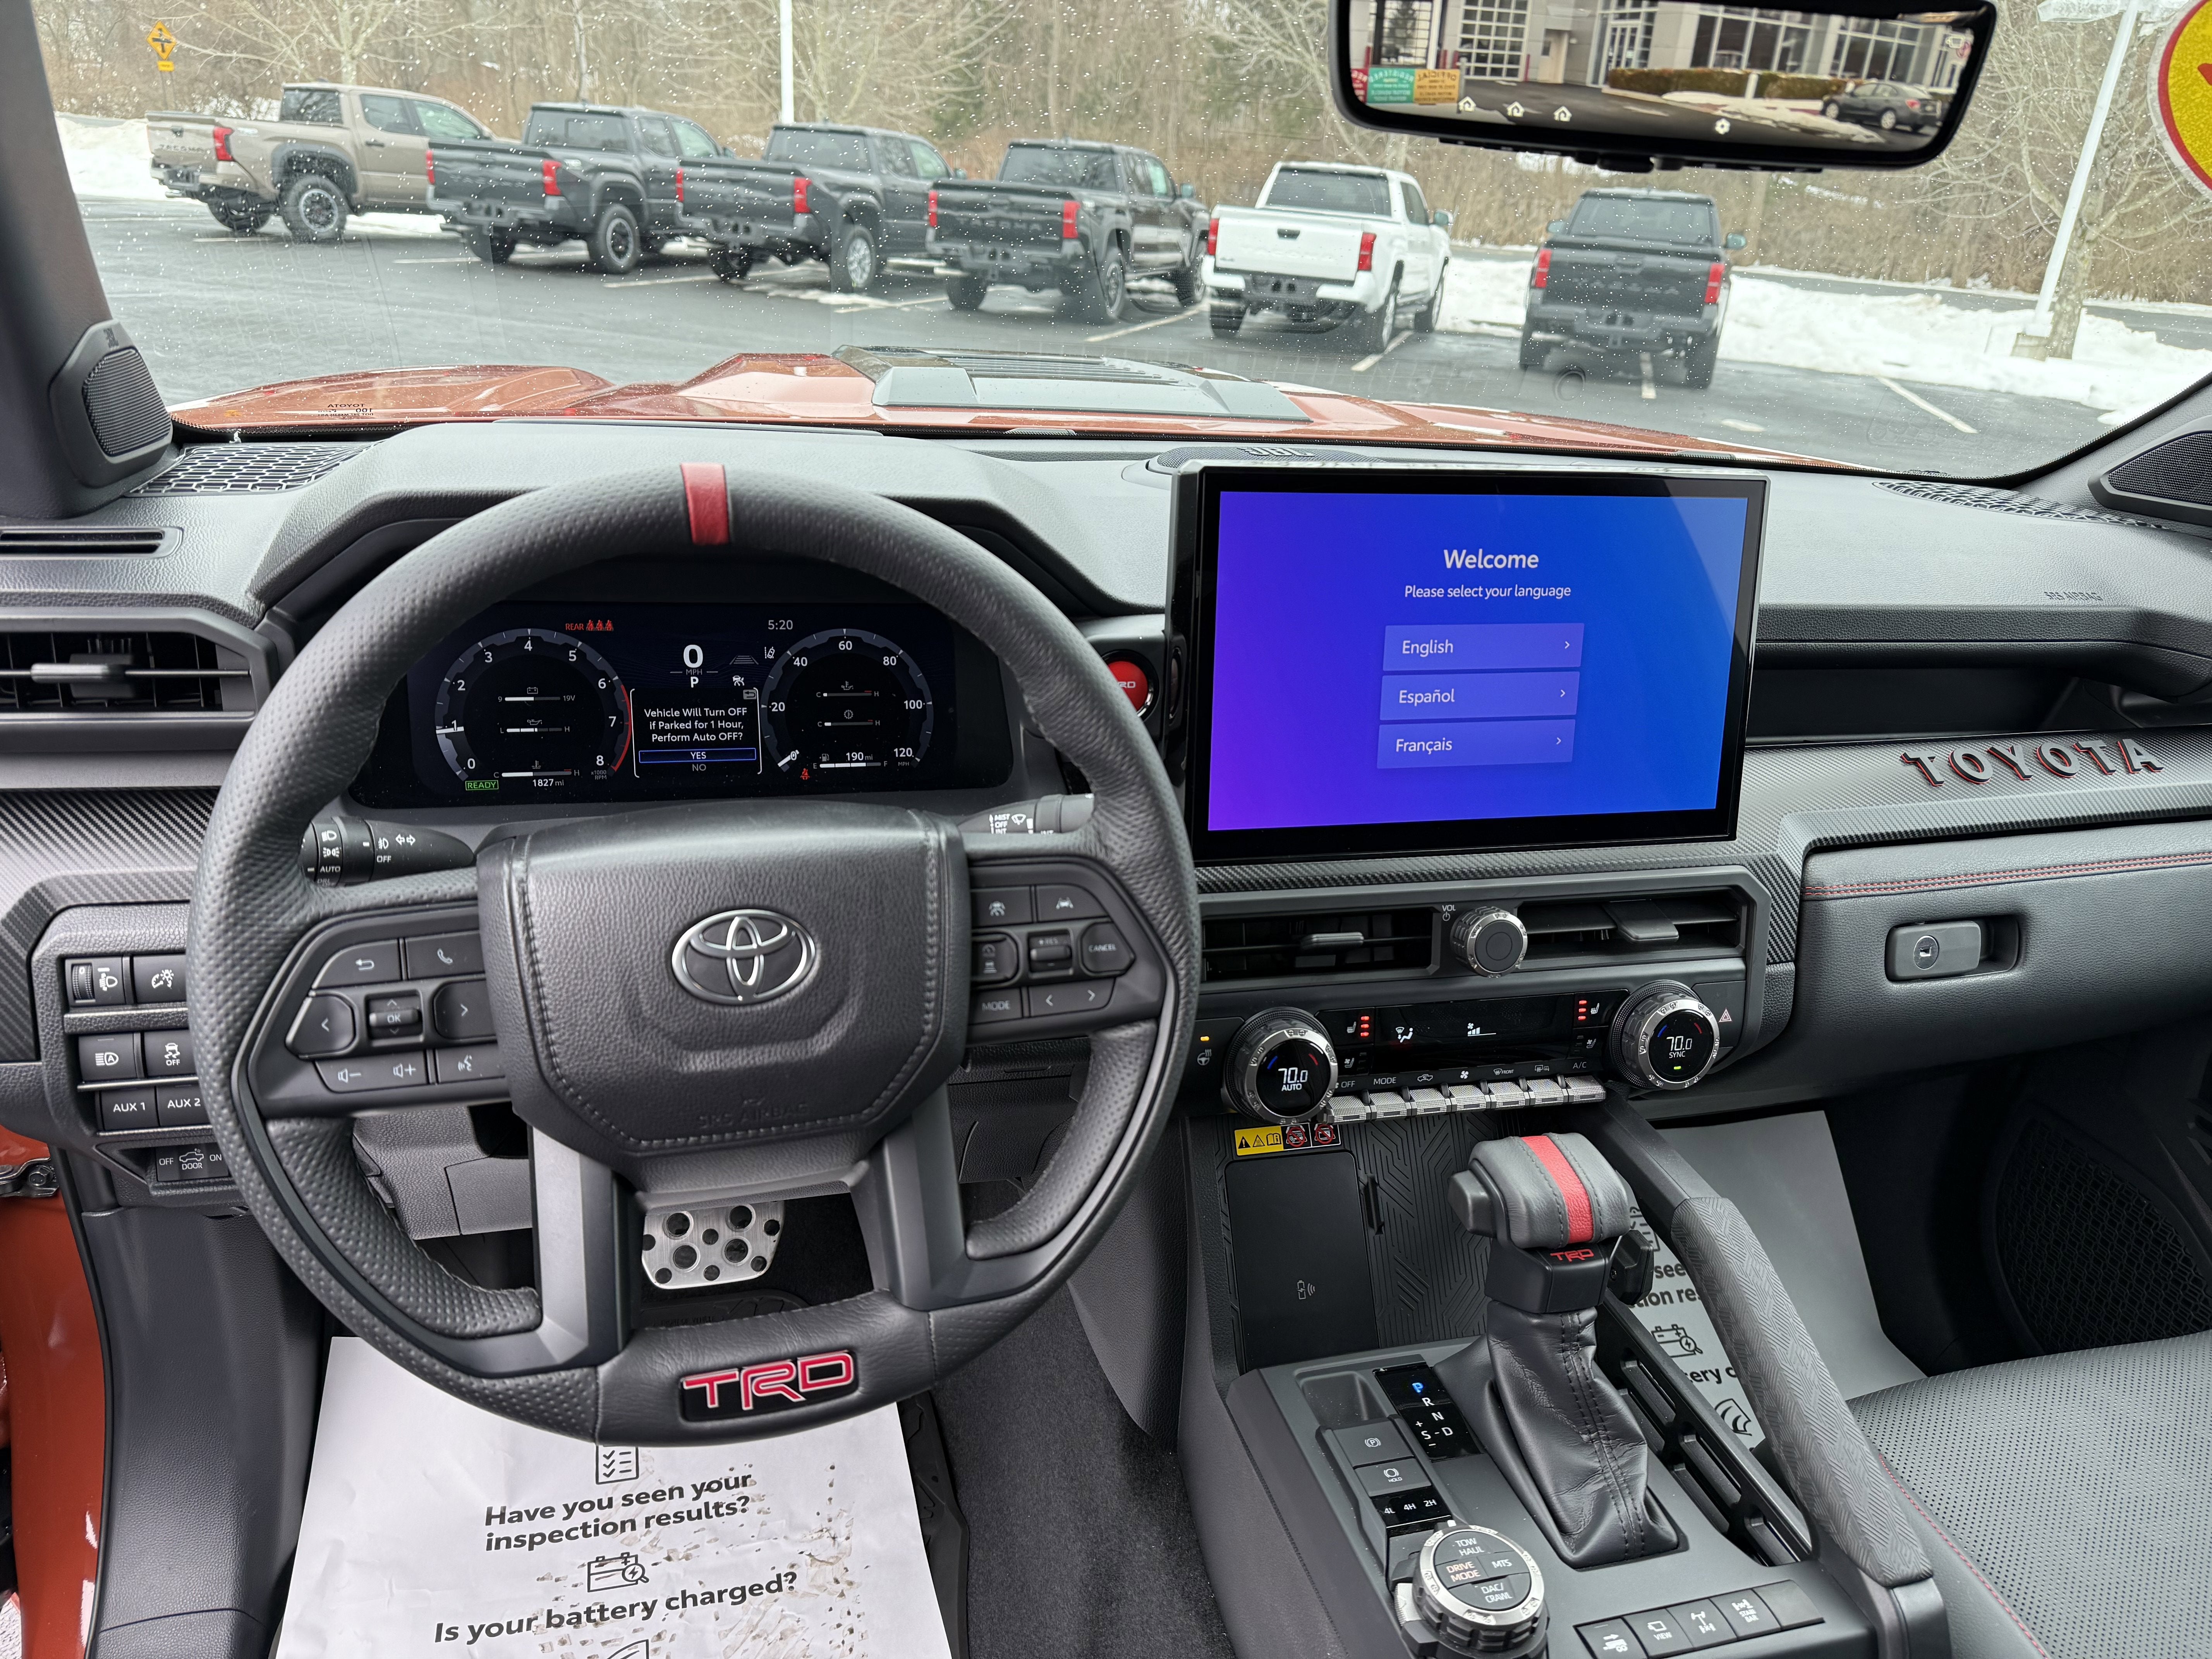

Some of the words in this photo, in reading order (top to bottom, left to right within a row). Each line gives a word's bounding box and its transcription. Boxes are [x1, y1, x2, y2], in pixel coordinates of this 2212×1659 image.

[1239, 447, 1315, 457] JBL
[1444, 548, 1539, 568] Welcome
[1405, 585, 1444, 598] Please
[1447, 585, 1483, 597] select
[1484, 587, 1512, 599] your
[1515, 584, 1571, 599] language
[768, 620, 793, 630] 5:20
[524, 641, 532, 651] 4
[838, 641, 852, 650] 60
[1402, 639, 1453, 657] English
[485, 652, 493, 663] 3
[569, 651, 577, 661] 5
[683, 644, 703, 668] 0
[883, 656, 896, 666] 80
[793, 657, 807, 666] 40
[457, 680, 465, 691] 2
[598, 678, 606, 689] 6
[690, 677, 699, 688] P
[1398, 689, 1455, 706] Español
[771, 702, 785, 711] 20
[904, 700, 922, 709] 100
[644, 709, 680, 718] Vehicle
[682, 708, 701, 716] Will
[704, 708, 725, 716] Turn
[728, 708, 747, 716] OFF
[451, 720, 457, 730] 1
[609, 716, 616, 726] 7
[650, 721, 656, 729] if
[659, 720, 691, 729] Parked
[694, 720, 708, 729] for
[718, 720, 744, 729] Hour,
[652, 733, 689, 742] Perform
[693, 733, 716, 741] Auto
[719, 732, 743, 740] OFF?
[1396, 737, 1452, 755] Français
[790, 751, 797, 760] 0
[846, 752, 864, 761] 190
[893, 747, 912, 757] 120
[467, 759, 476, 769] 0
[596, 755, 604, 766] 8
[1900, 738, 2163, 787] TOYOTA
[1089, 944, 1116, 952] CANCEL
[982, 1001, 1010, 1011] MODE
[388, 1014, 400, 1023] OK
[1666, 1036, 1692, 1050] 70.0
[1278, 1067, 1308, 1084] 70.0
[1373, 1077, 1396, 1085] MODE
[113, 1104, 138, 1112] AUX
[167, 1099, 191, 1108] AUX
[194, 1098, 201, 1106] 2
[1550, 1249, 1594, 1262] TRD
[1654, 1263, 1686, 1279] see
[680, 1350, 854, 1410] TRD
[1412, 1382, 1424, 1393] P
[1422, 1397, 1434, 1406] R
[1432, 1412, 1444, 1421] N
[1421, 1431, 1431, 1439] S
[1441, 1427, 1453, 1436] D
[485, 1504, 555, 1527] Have
[562, 1497, 613, 1521] you
[621, 1486, 684, 1508] seen
[691, 1474, 752, 1501] your
[486, 1518, 637, 1551] inspection
[644, 1496, 750, 1528] results?
[1455, 1538, 1477, 1547] TOW
[1460, 1547, 1484, 1556] HAUL
[1446, 1561, 1475, 1573] DRIVE
[1491, 1559, 1512, 1568] MTS
[1451, 1570, 1481, 1582] MODE
[1481, 1582, 1504, 1594] DAC/
[1485, 1593, 1513, 1603] CRAWL
[435, 1623, 459, 1643] Is
[467, 1615, 540, 1645] your
[546, 1597, 658, 1628] battery
[665, 1571, 797, 1611] charged?
[1653, 1632, 1673, 1640] VIEW
